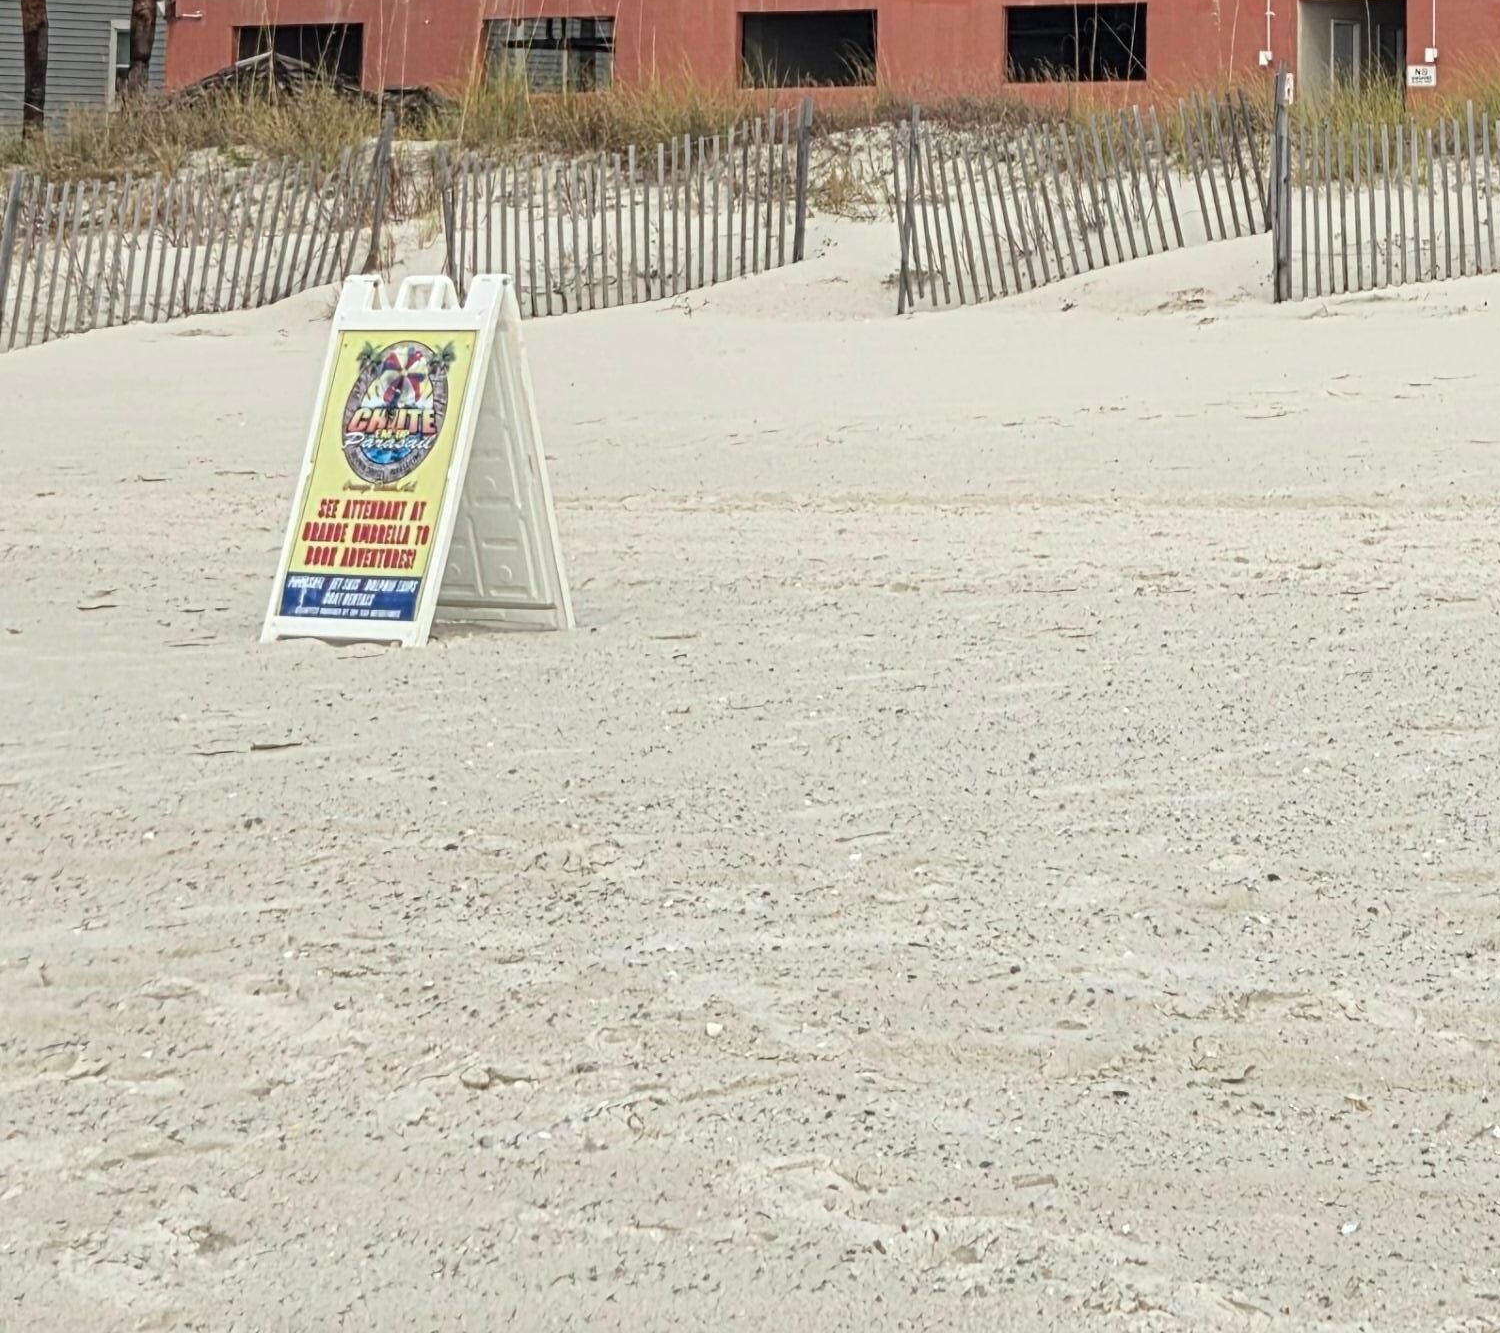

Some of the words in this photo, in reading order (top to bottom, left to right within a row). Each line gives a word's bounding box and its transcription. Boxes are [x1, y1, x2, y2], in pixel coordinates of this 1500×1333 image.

[341, 432, 437, 449] Parasail
[318, 499, 339, 518] SEE
[342, 499, 407, 520] ATTENDANT
[410, 501, 427, 521] AT
[302, 522, 348, 542] ORANGE
[352, 523, 410, 544] UMBRELLA
[415, 525, 430, 545] TO
[304, 545, 338, 566] BOOK
[341, 547, 416, 569] ADVENTURES!
